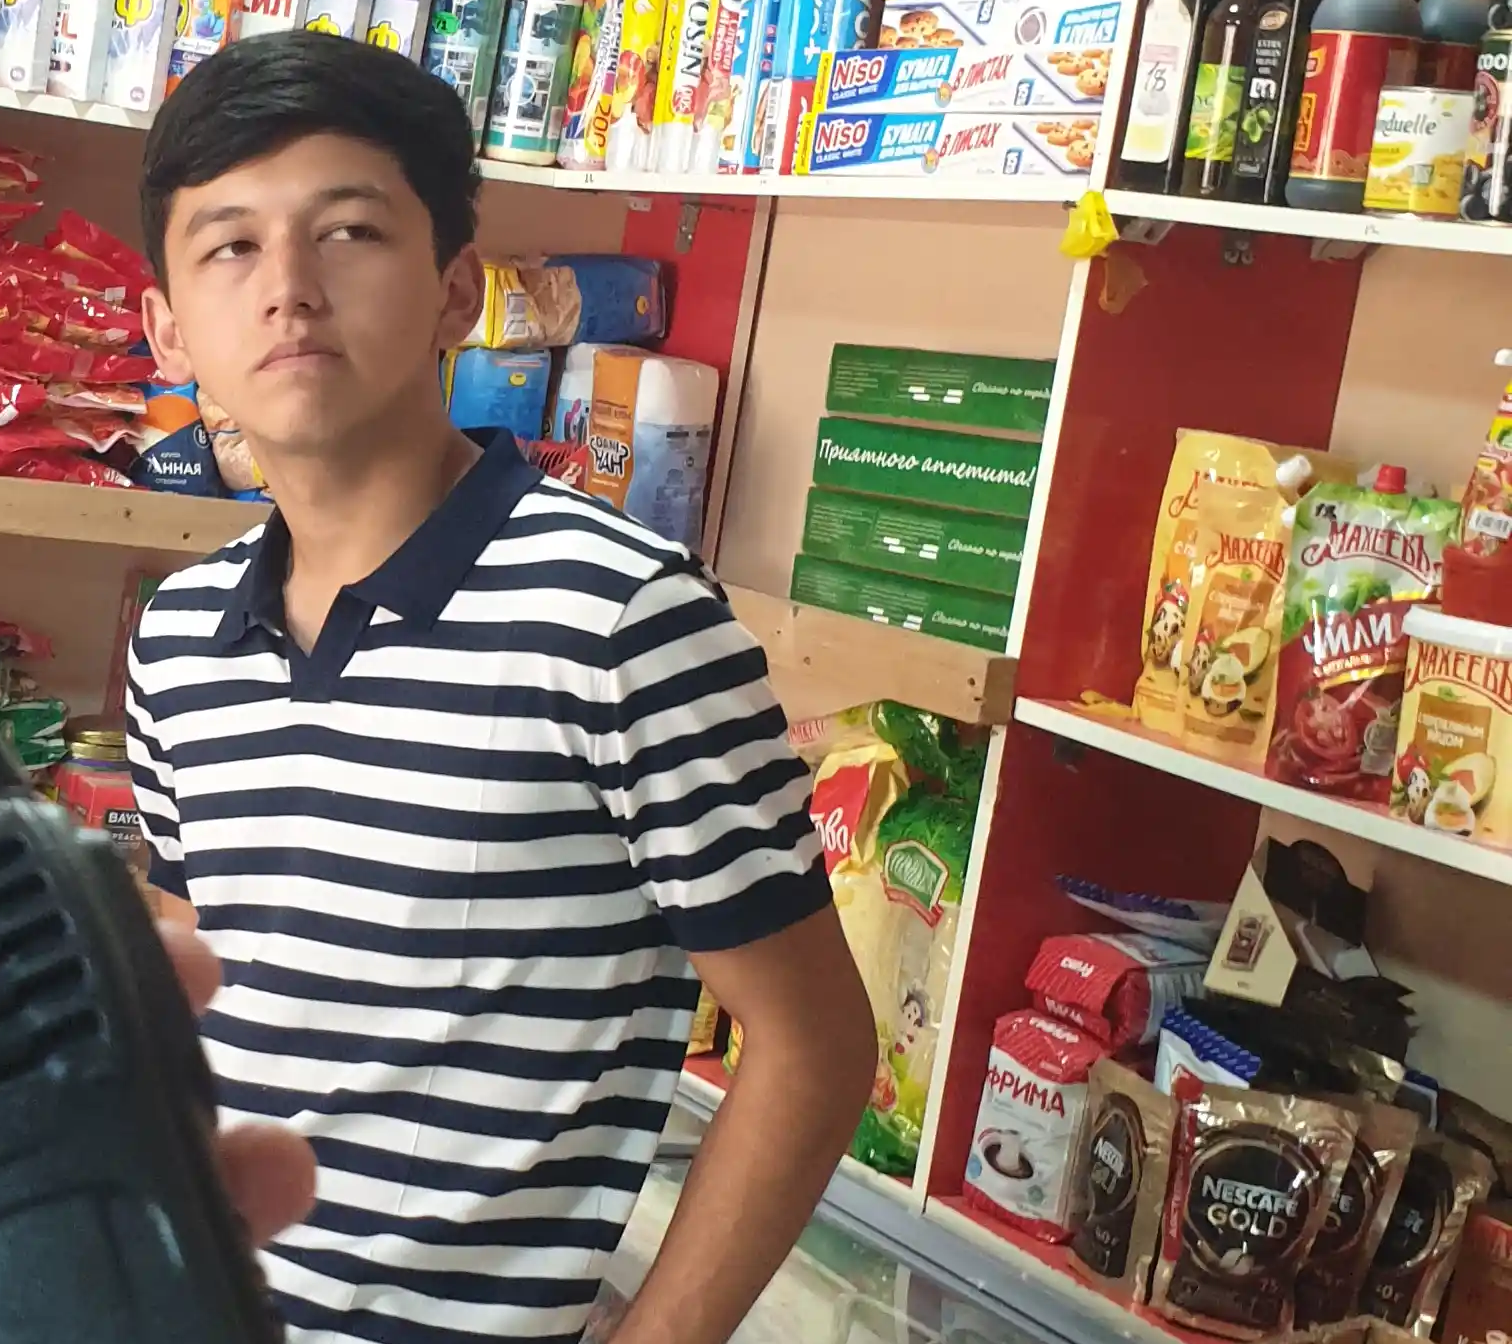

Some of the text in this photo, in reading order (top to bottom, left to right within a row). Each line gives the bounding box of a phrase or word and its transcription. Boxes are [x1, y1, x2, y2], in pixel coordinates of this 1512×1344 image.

[680, 1, 710, 78] NISO
[832, 55, 885, 91] Niso
[815, 117, 869, 155] Niso
[819, 439, 1038, 487] Приятного аппетита!
[1303, 612, 1393, 665] ЧИЛИ
[988, 1064, 1067, 1118] ФРИМА
[1205, 1200, 1289, 1240] GOLD
